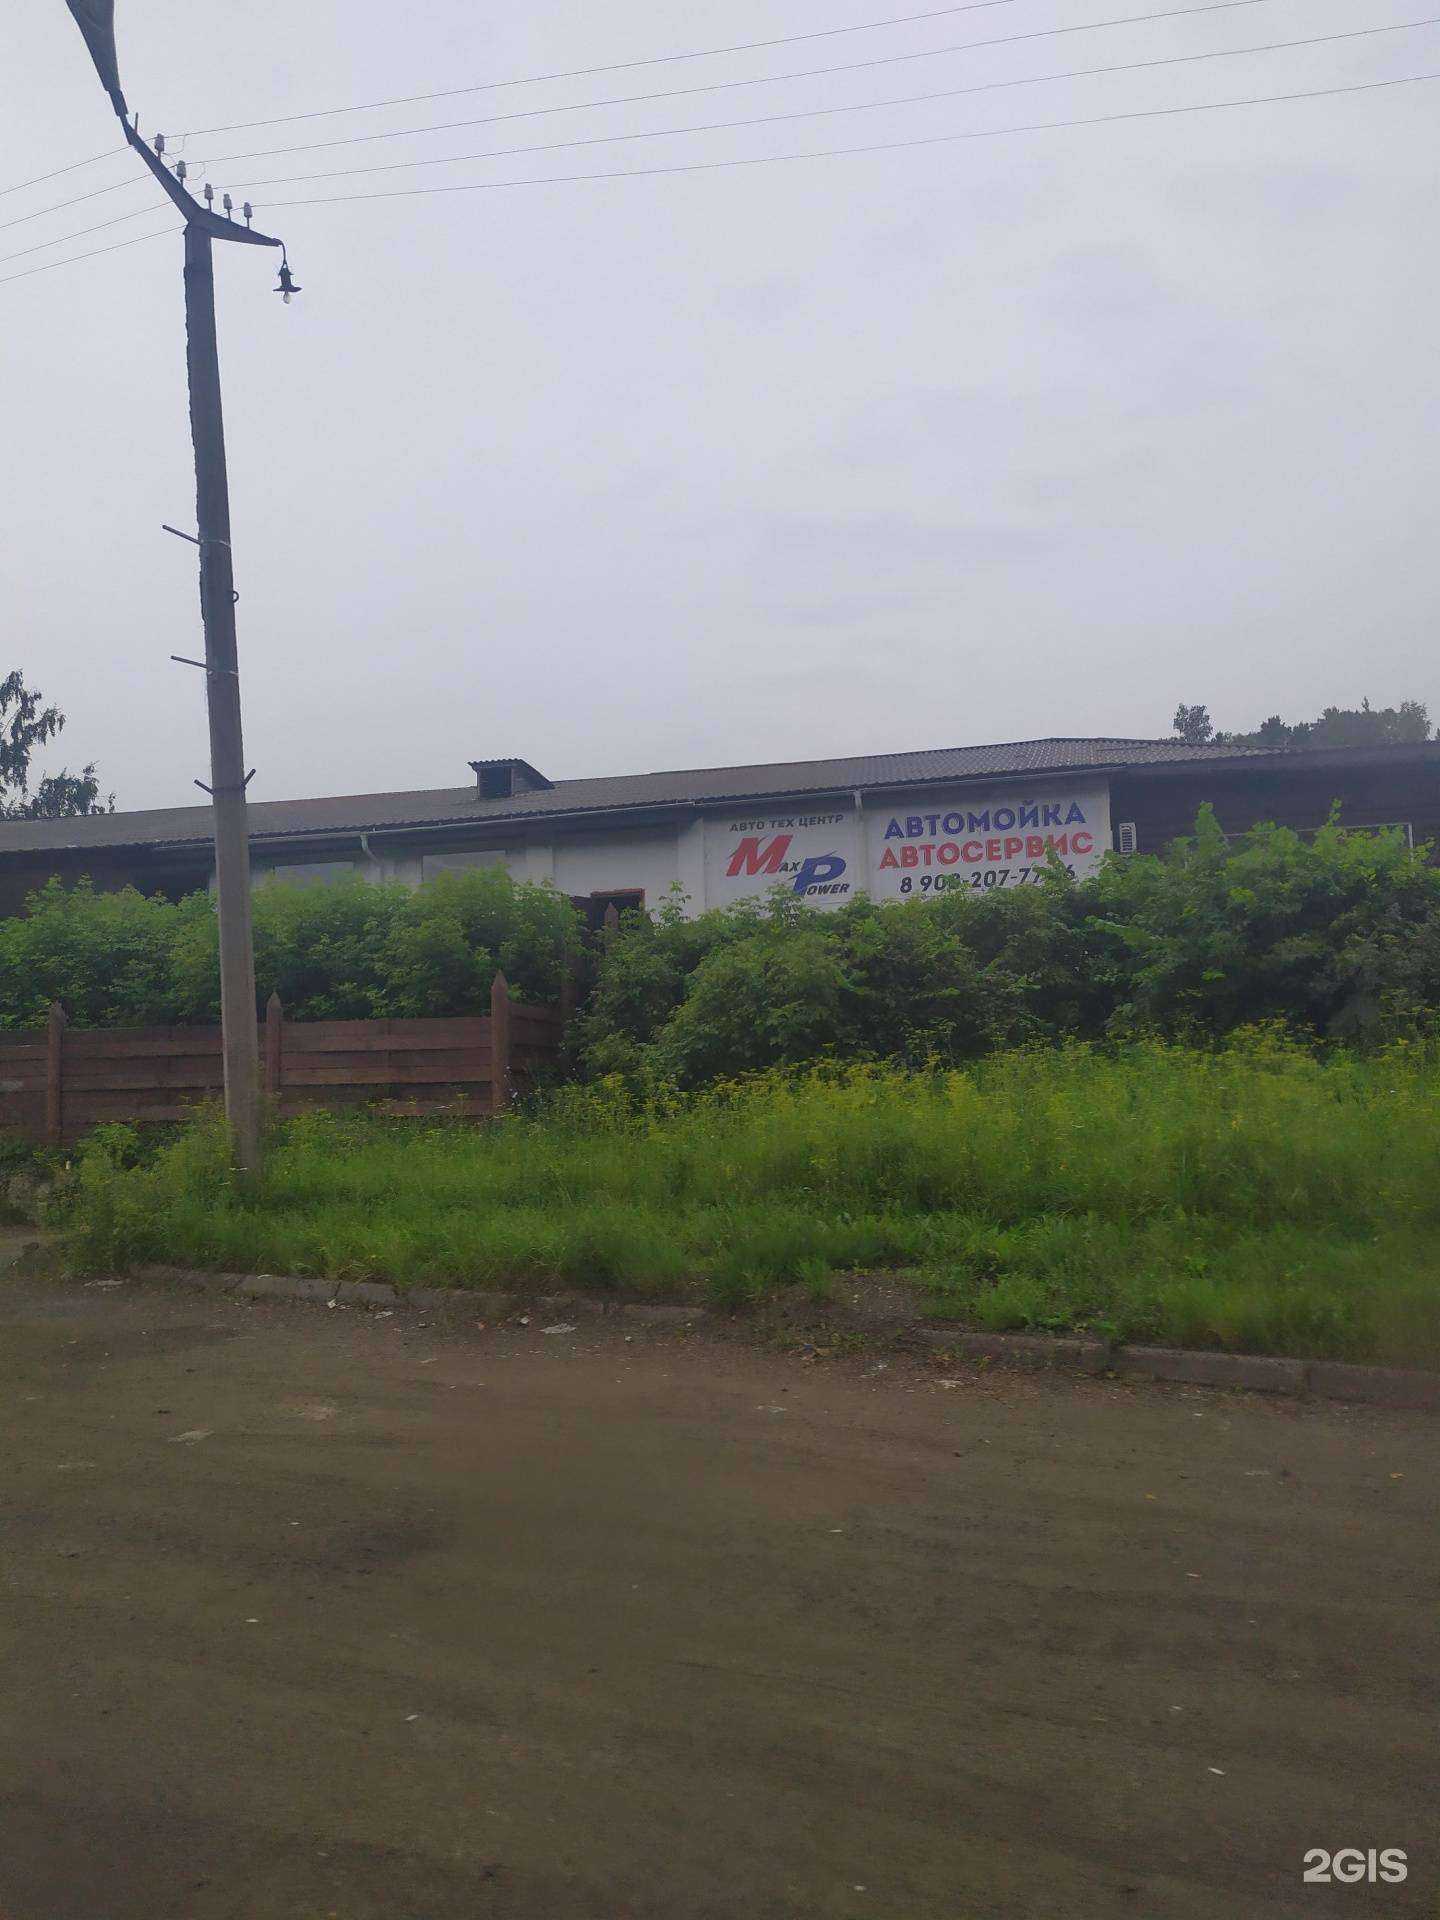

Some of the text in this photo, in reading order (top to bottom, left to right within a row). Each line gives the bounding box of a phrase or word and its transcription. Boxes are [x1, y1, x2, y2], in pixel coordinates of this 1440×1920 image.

[730, 814, 844, 832] АВТО ТЕХ ЦЕНТР
[883, 800, 1087, 840] АВТОМОЙКА
[879, 831, 1094, 870] АВТОСЕРВИС
[900, 876, 913, 894] 8
